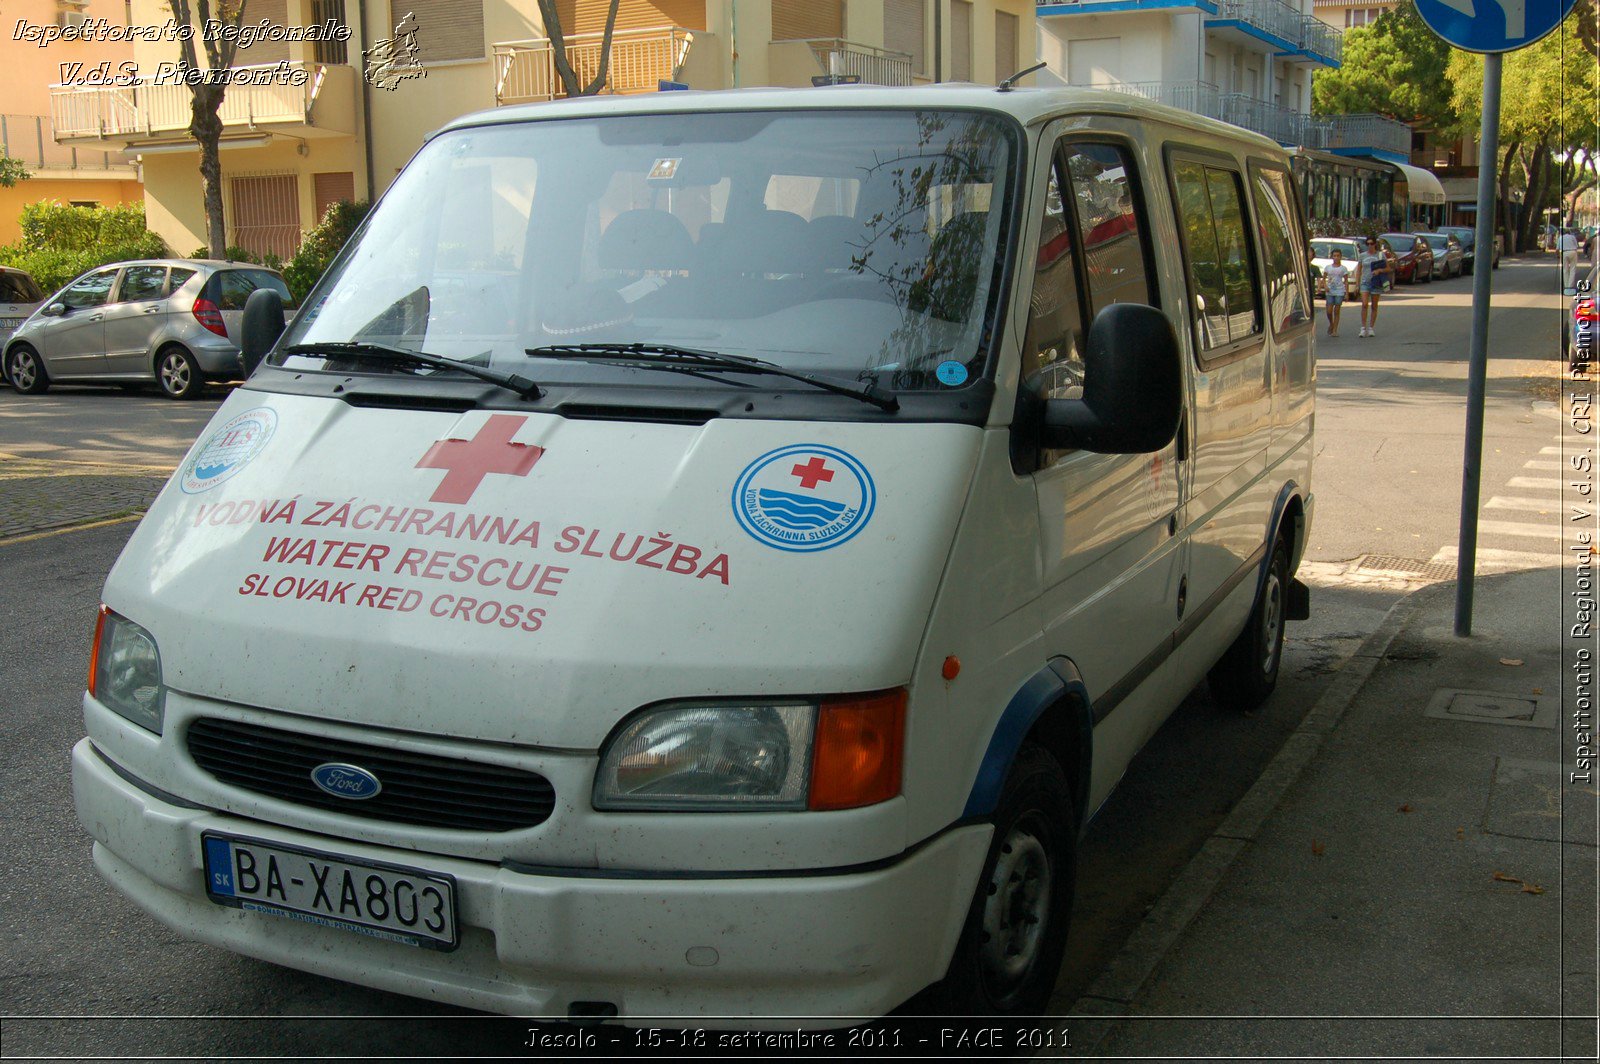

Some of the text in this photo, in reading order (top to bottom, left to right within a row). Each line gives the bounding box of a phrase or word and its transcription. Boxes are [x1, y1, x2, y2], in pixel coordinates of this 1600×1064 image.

[193, 494, 731, 586] VODNÁ ZÁCHRANNA SLUŽBA
[262, 535, 571, 597] WATER RESCUE
[238, 573, 547, 633] SLOVAK RED CROSS
[326, 769, 365, 793] Ford
[214, 872, 231, 887] SK
[234, 847, 447, 934] BA-XA803
